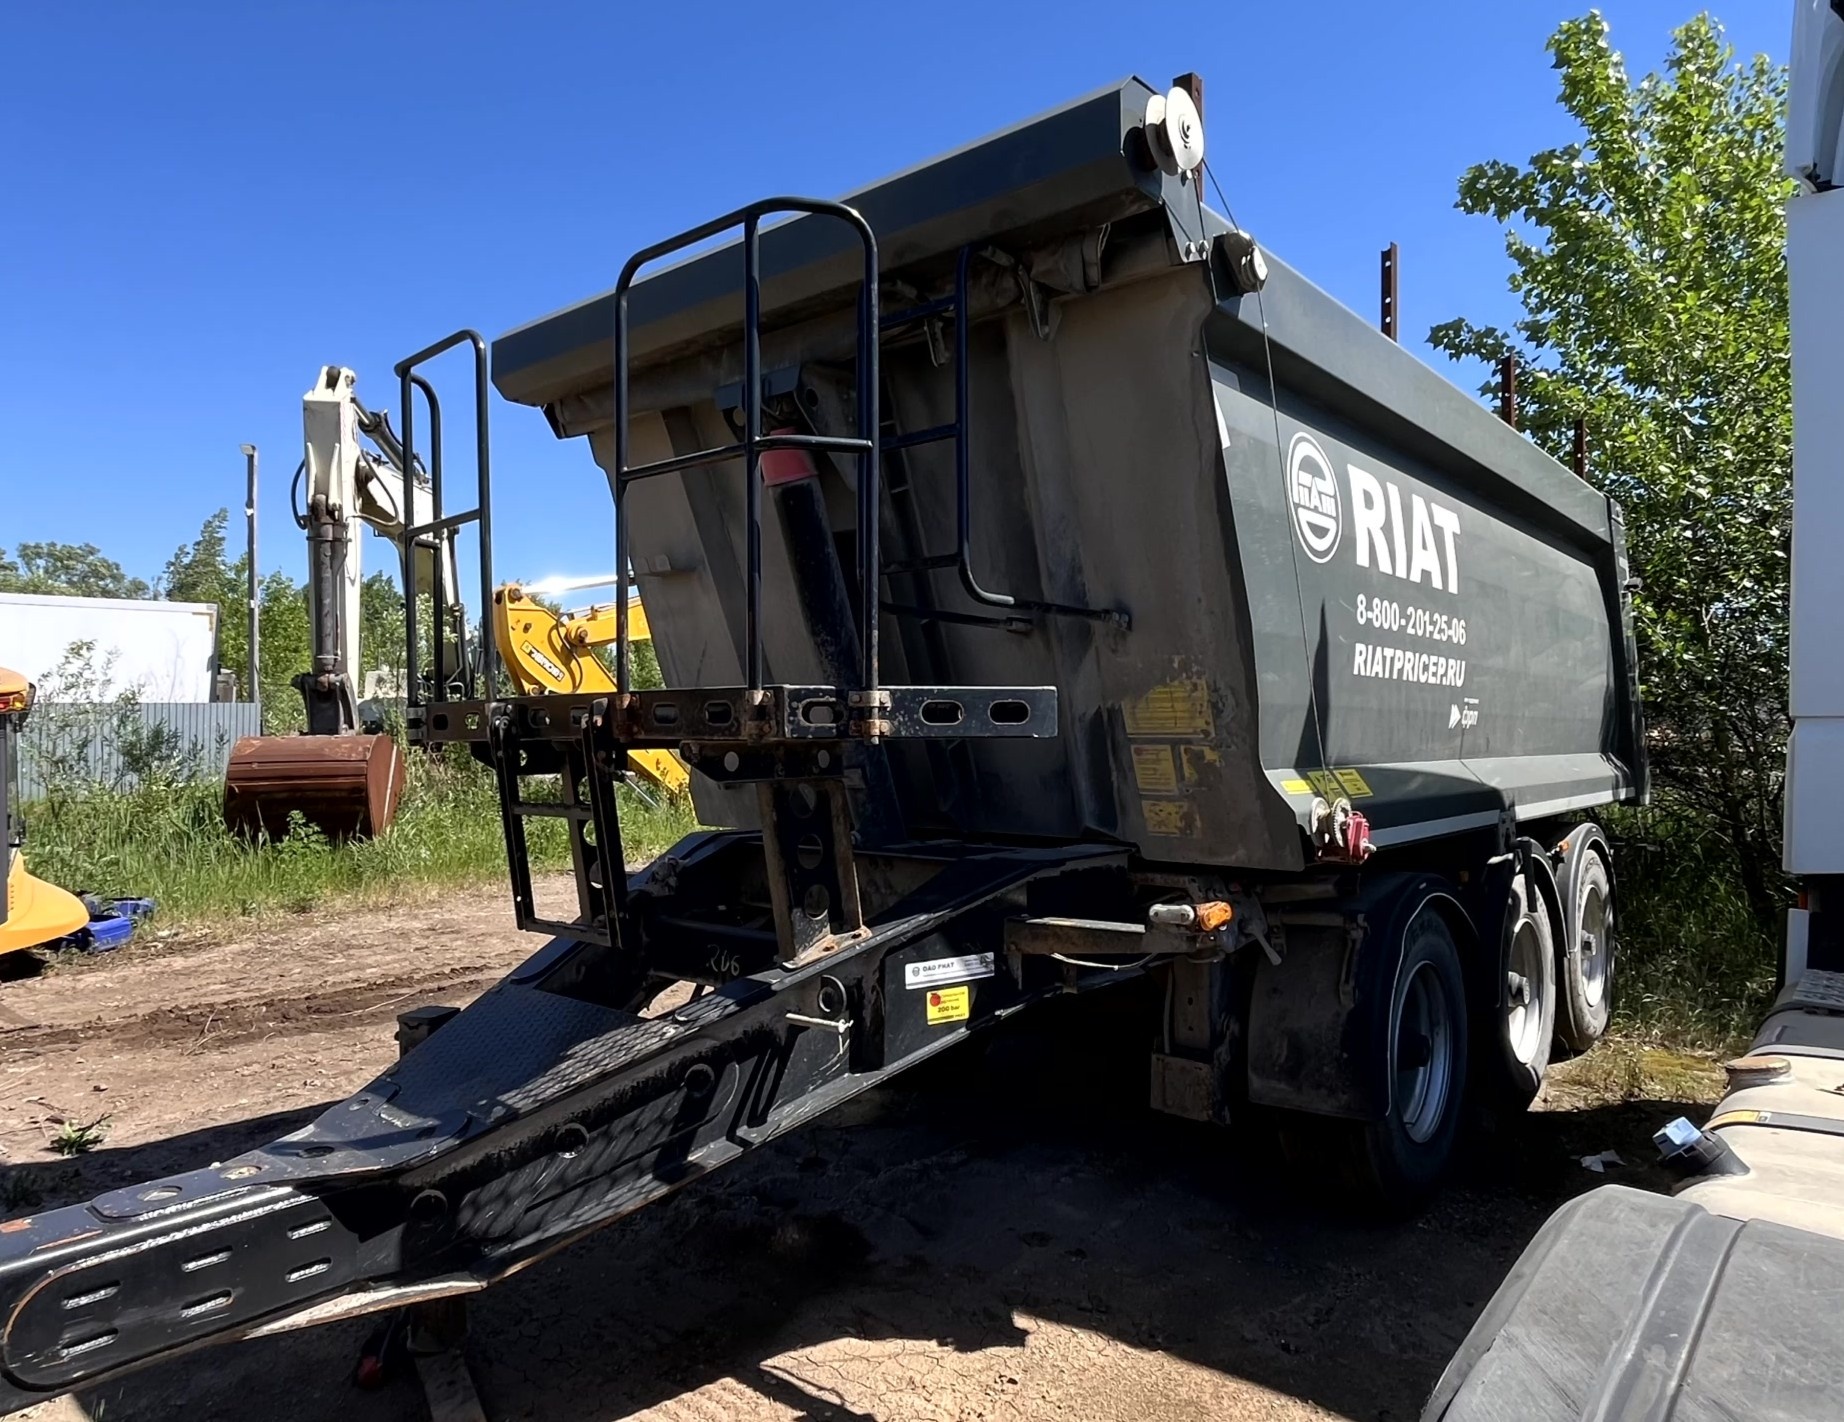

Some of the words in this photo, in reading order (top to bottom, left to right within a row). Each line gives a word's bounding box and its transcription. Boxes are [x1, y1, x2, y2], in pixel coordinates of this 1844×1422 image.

[1347, 463, 1461, 595] RIAT
[1356, 593, 1467, 646] 8-800-201-25-06
[1353, 643, 1466, 688] RIATPRICEP.RU
